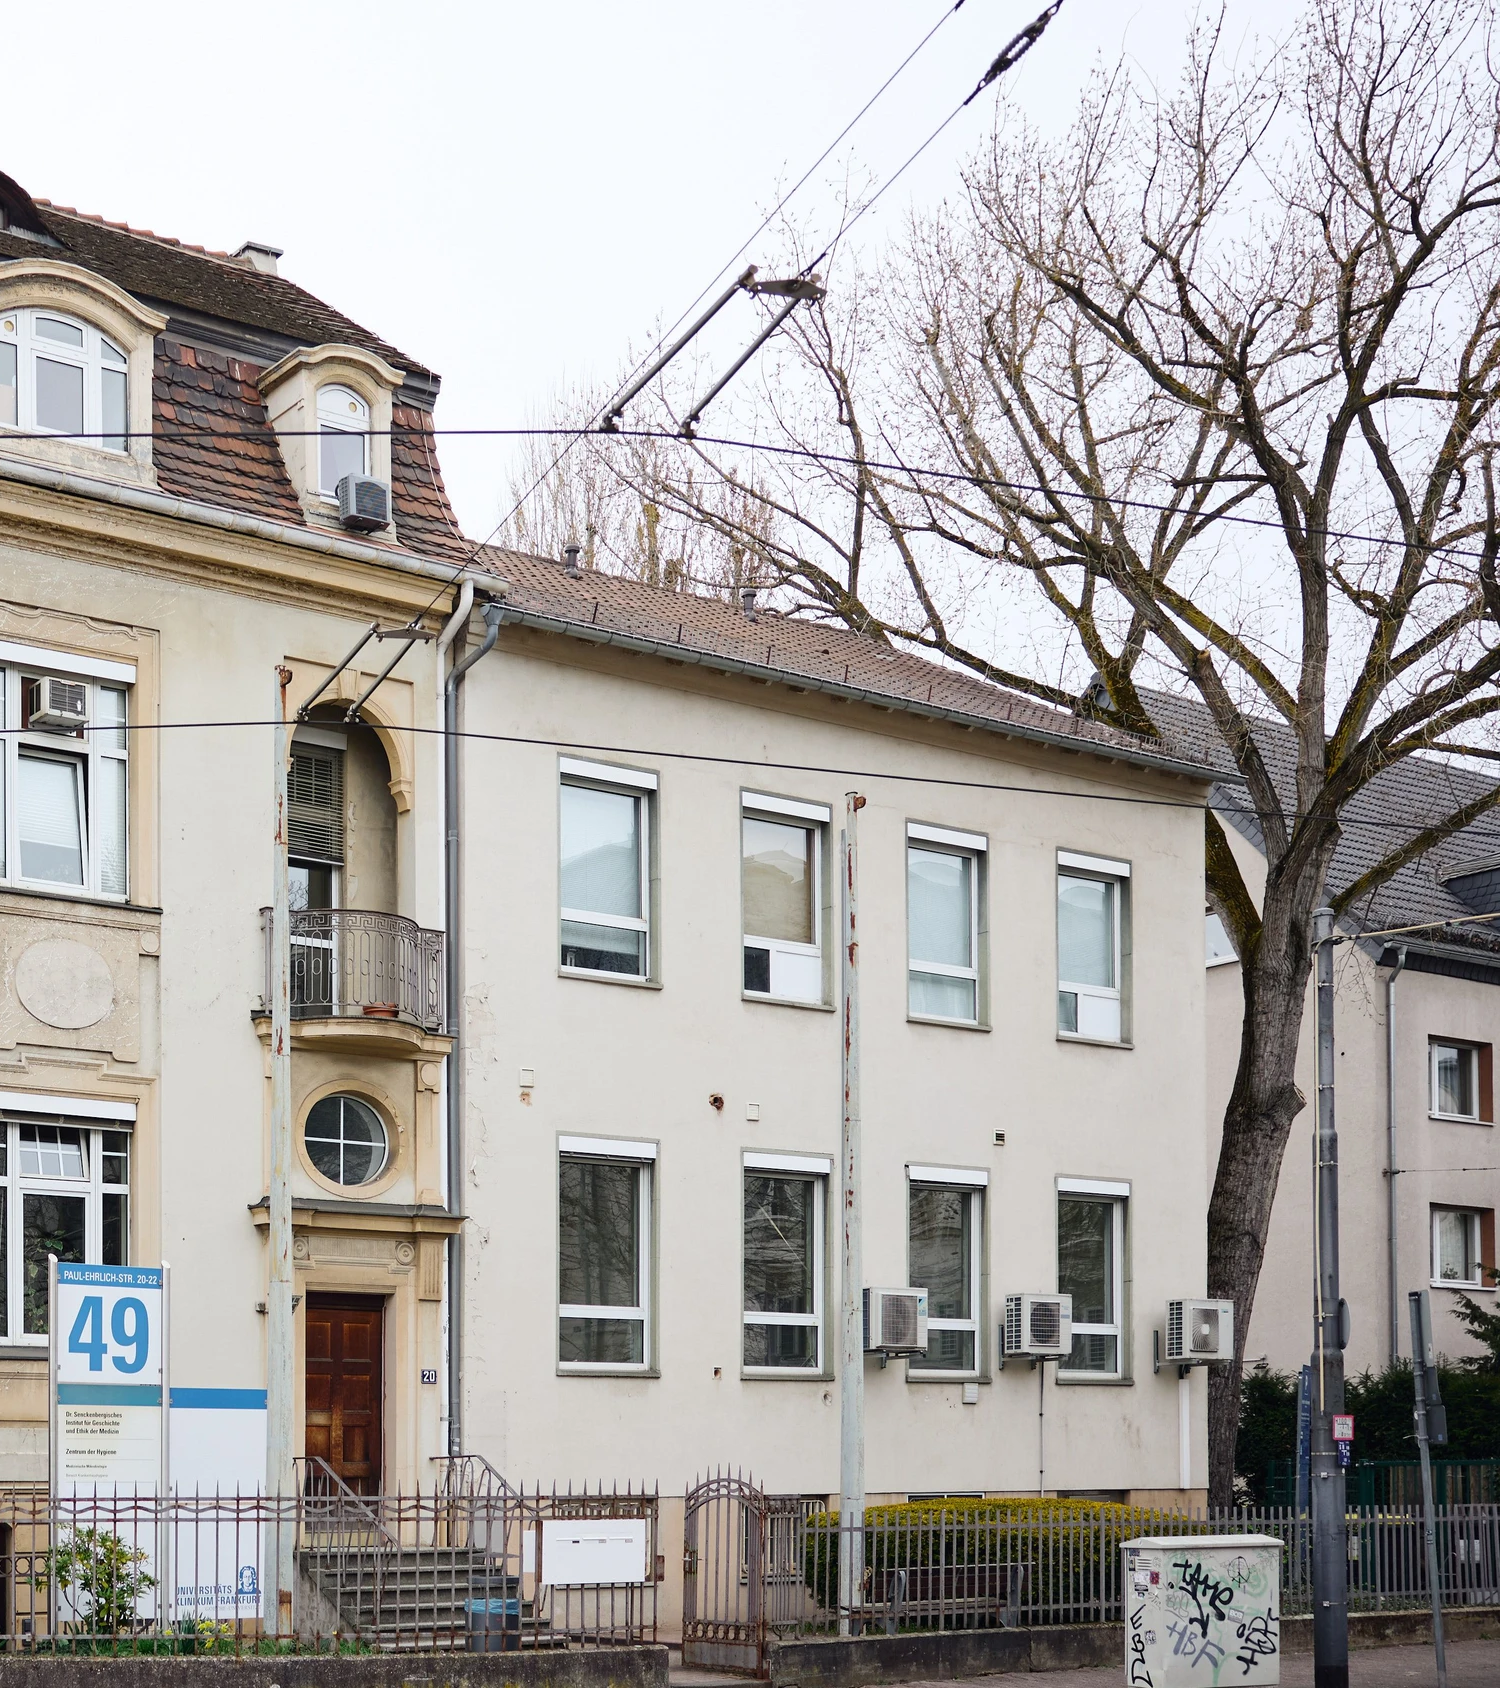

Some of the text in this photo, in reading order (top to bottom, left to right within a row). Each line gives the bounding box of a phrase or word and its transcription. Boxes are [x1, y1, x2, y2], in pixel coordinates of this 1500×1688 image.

[63, 1270, 158, 1285] PAUL-EHRLICH-STR. 20-22
[68, 1295, 150, 1374] 49
[422, 1370, 436, 1383] 20
[96, 1449, 116, 1457] Hygiene
[176, 1584, 232, 1596] UNIVRSITÄTS
